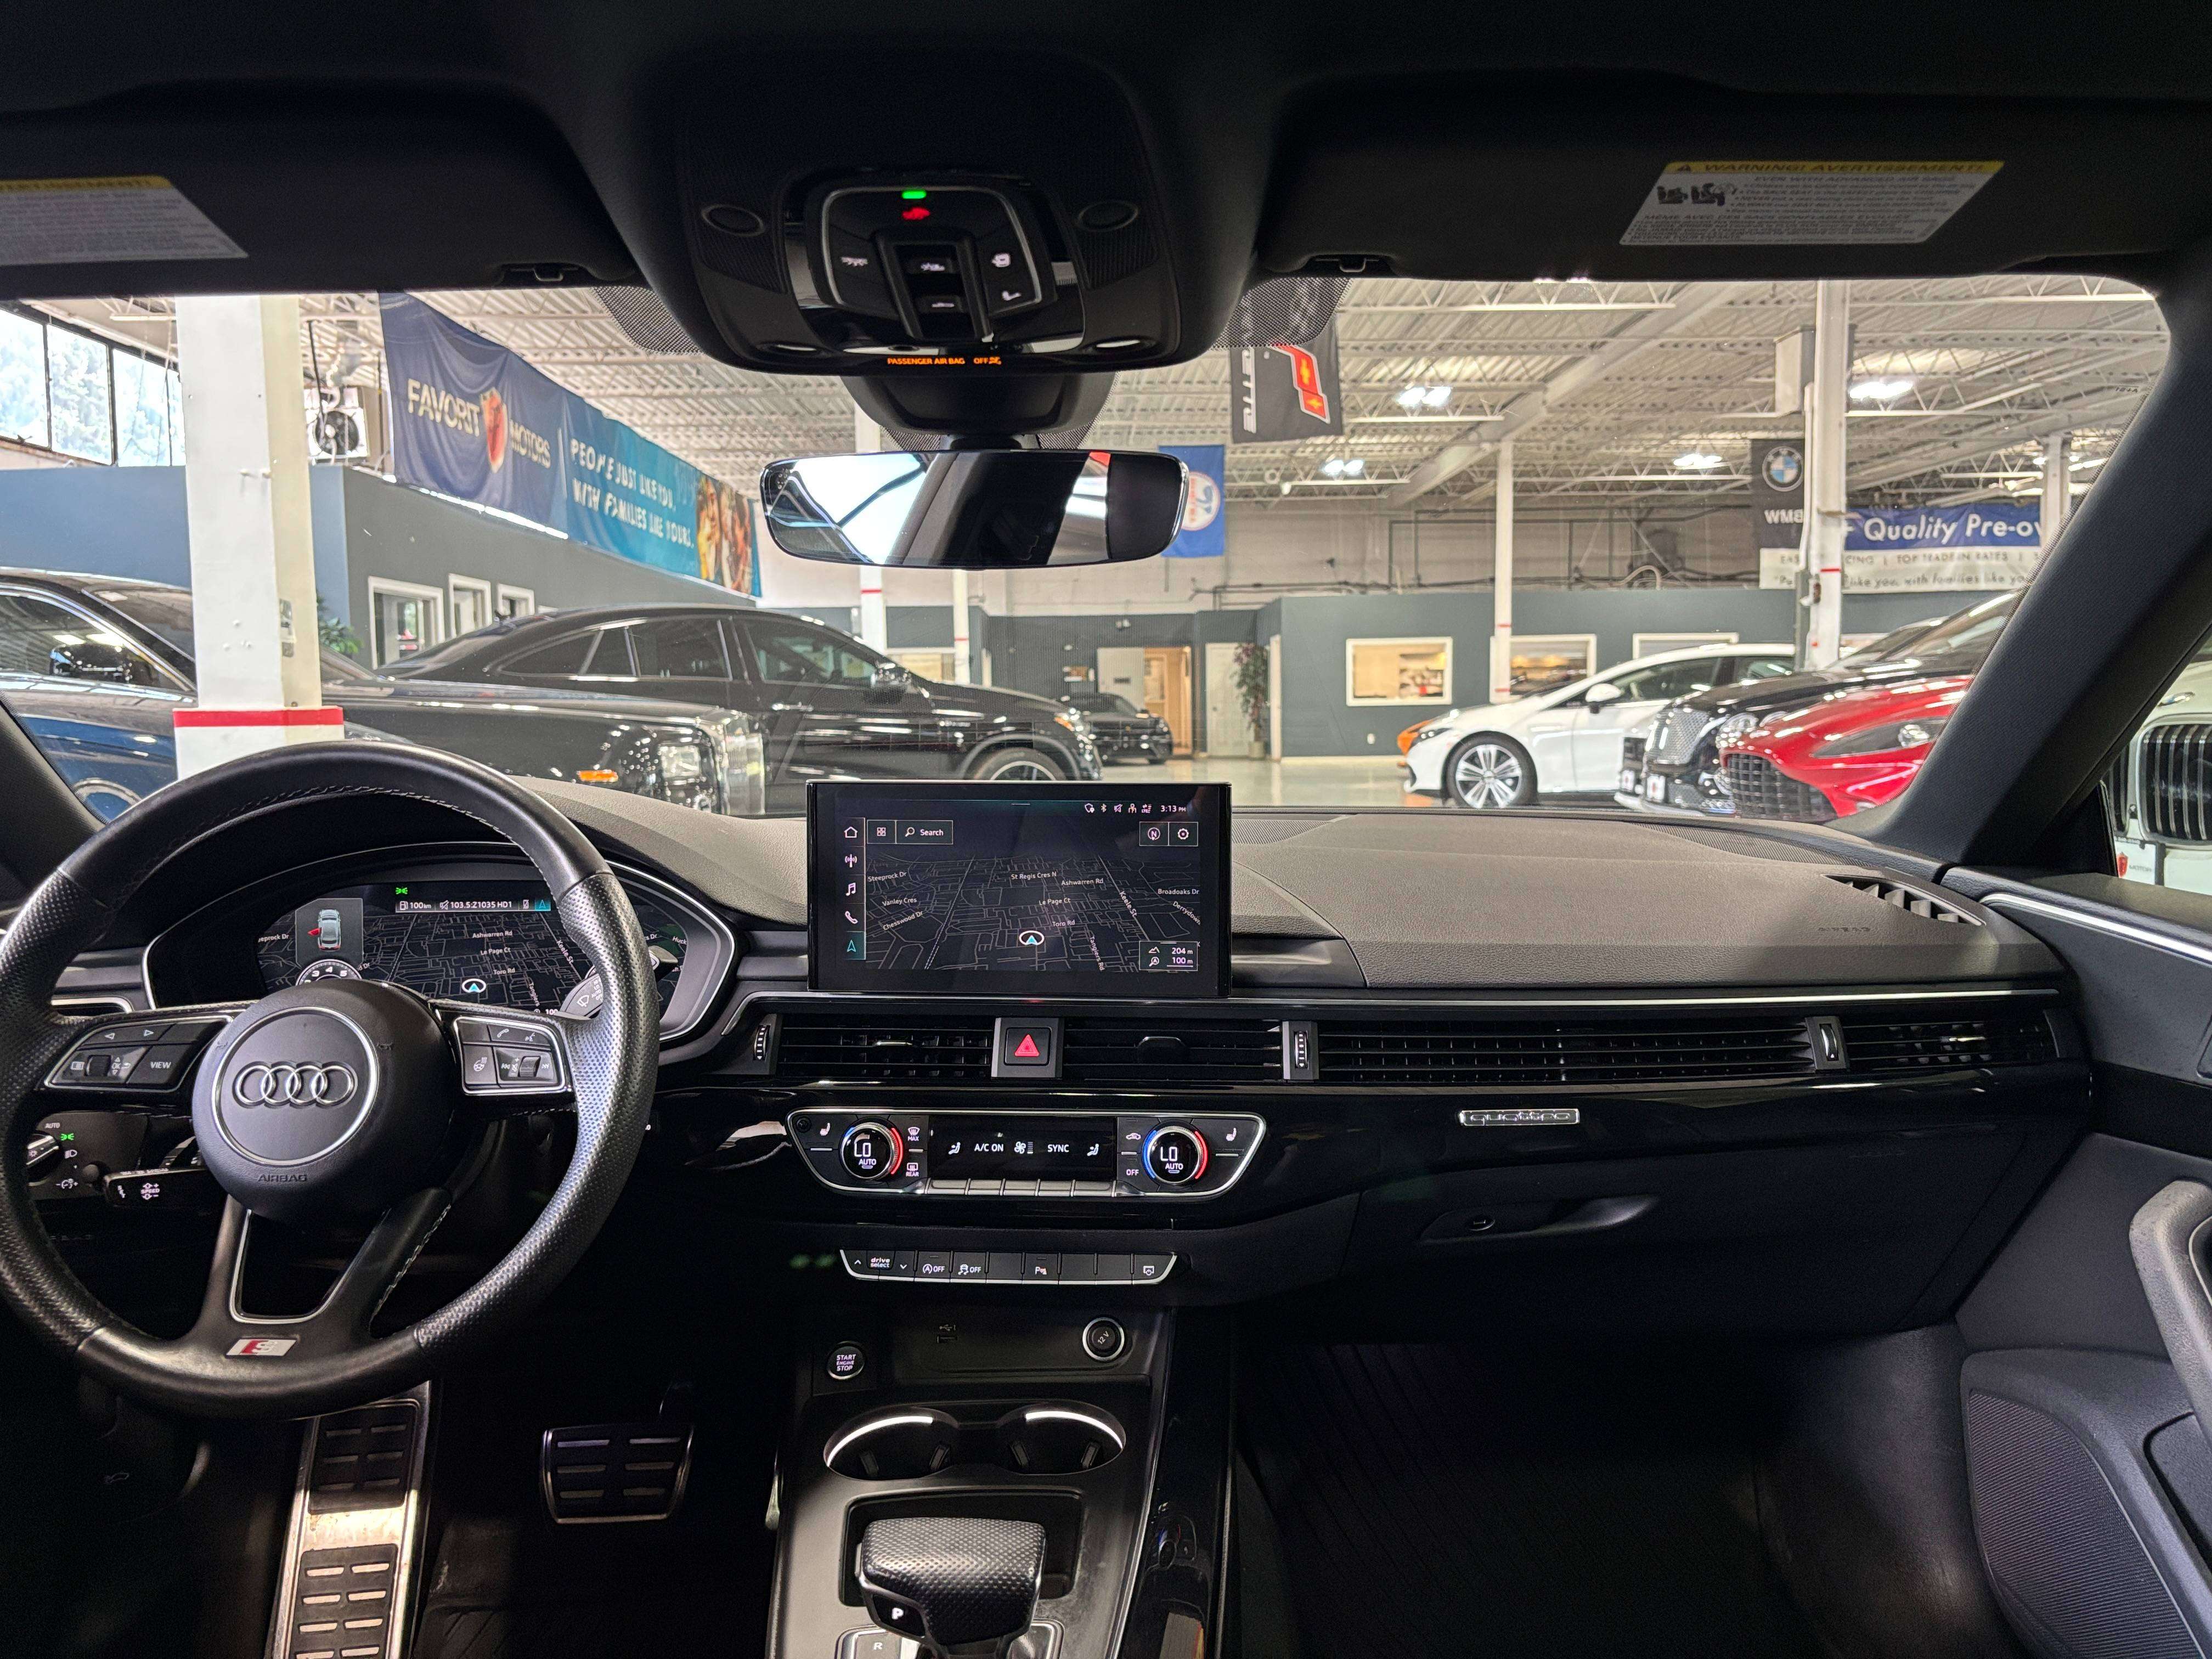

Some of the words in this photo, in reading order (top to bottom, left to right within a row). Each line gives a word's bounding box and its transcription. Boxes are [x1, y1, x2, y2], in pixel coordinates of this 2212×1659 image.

[408, 378, 481, 437] FAVORIT
[509, 419, 551, 469] MOTORS
[572, 477, 601, 512] WITH
[604, 493, 647, 531] FAMILIES
[1864, 515, 1958, 545] Quality
[920, 828, 944, 837] Search
[868, 874, 899, 882] Steeprock
[882, 899, 903, 907] Vanley
[1119, 891, 1132, 909] Keele
[883, 916, 916, 931] Chesswood
[556, 940, 568, 957] Keele
[974, 1143, 989, 1152] A/C
[991, 1143, 1003, 1152] ON
[1047, 1144, 1069, 1153] SYNC
[258, 1174, 308, 1183] AIRBAG
[891, 1607, 904, 1620] P
